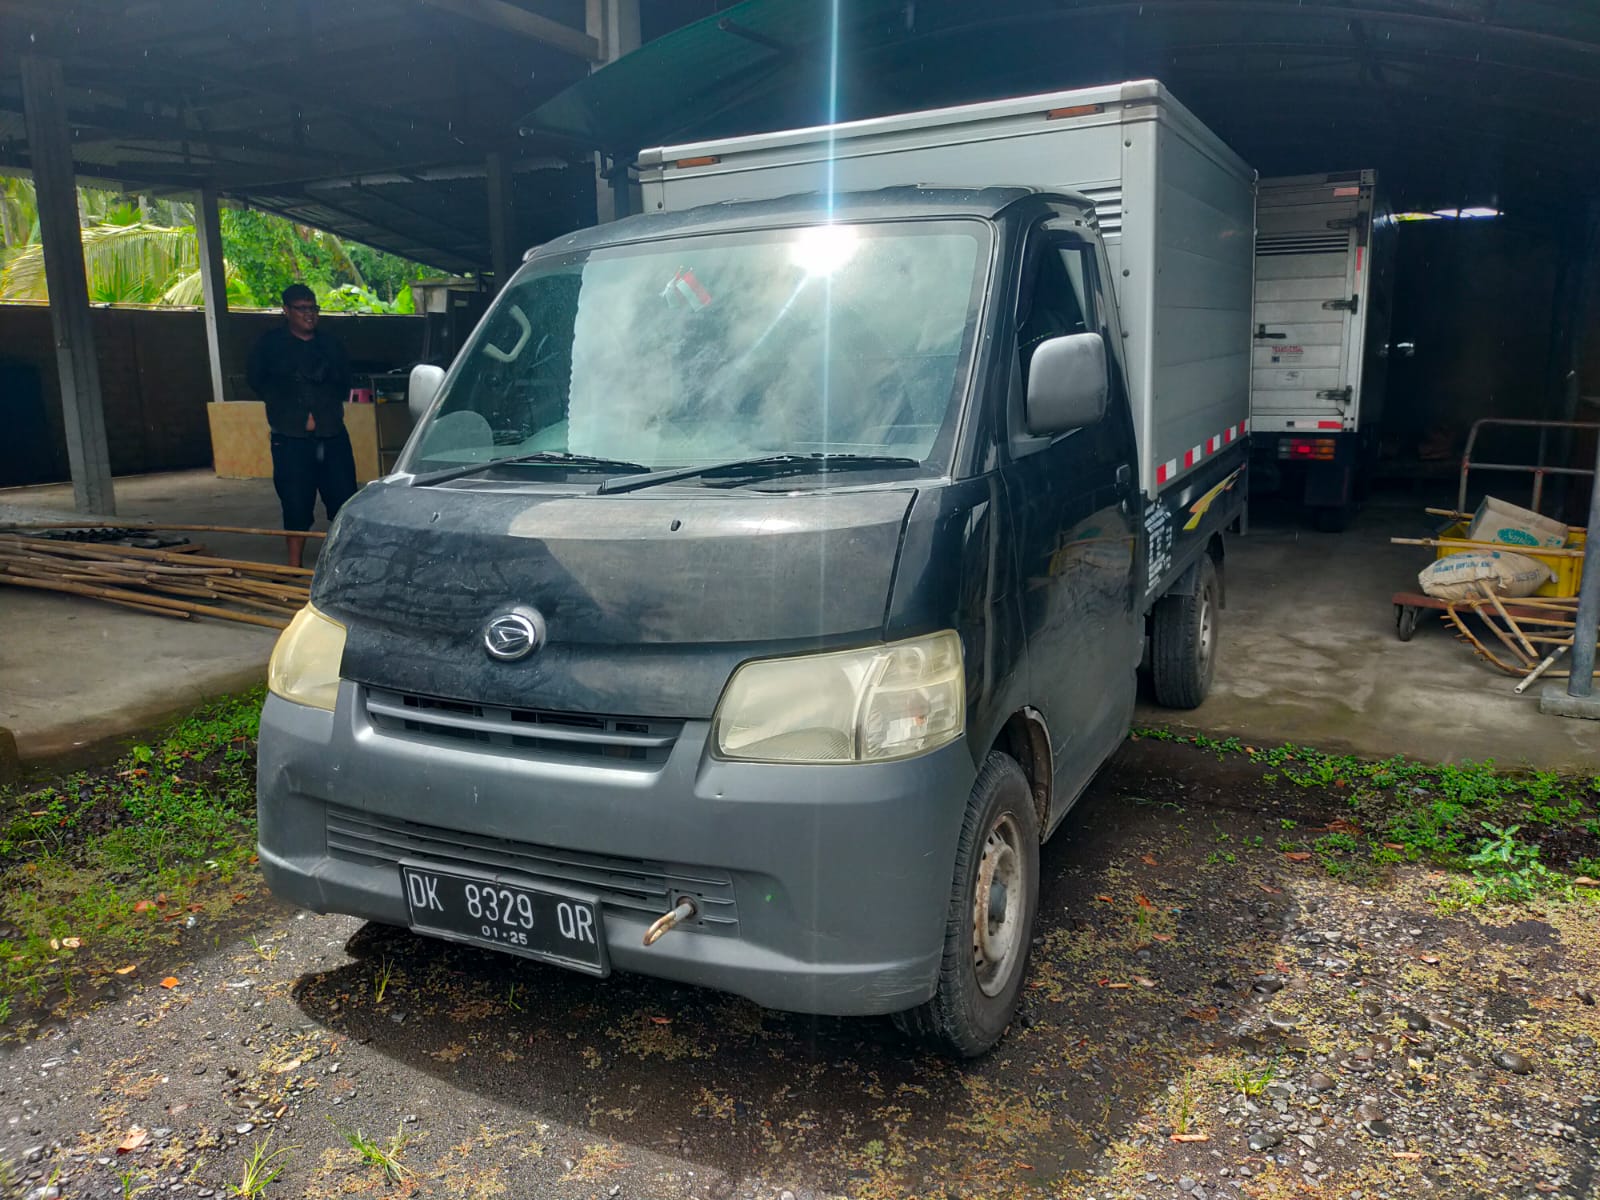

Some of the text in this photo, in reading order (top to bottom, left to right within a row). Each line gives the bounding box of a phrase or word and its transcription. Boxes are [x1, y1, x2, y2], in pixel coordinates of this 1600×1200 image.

[408, 873, 595, 944] DK 8329 QR
